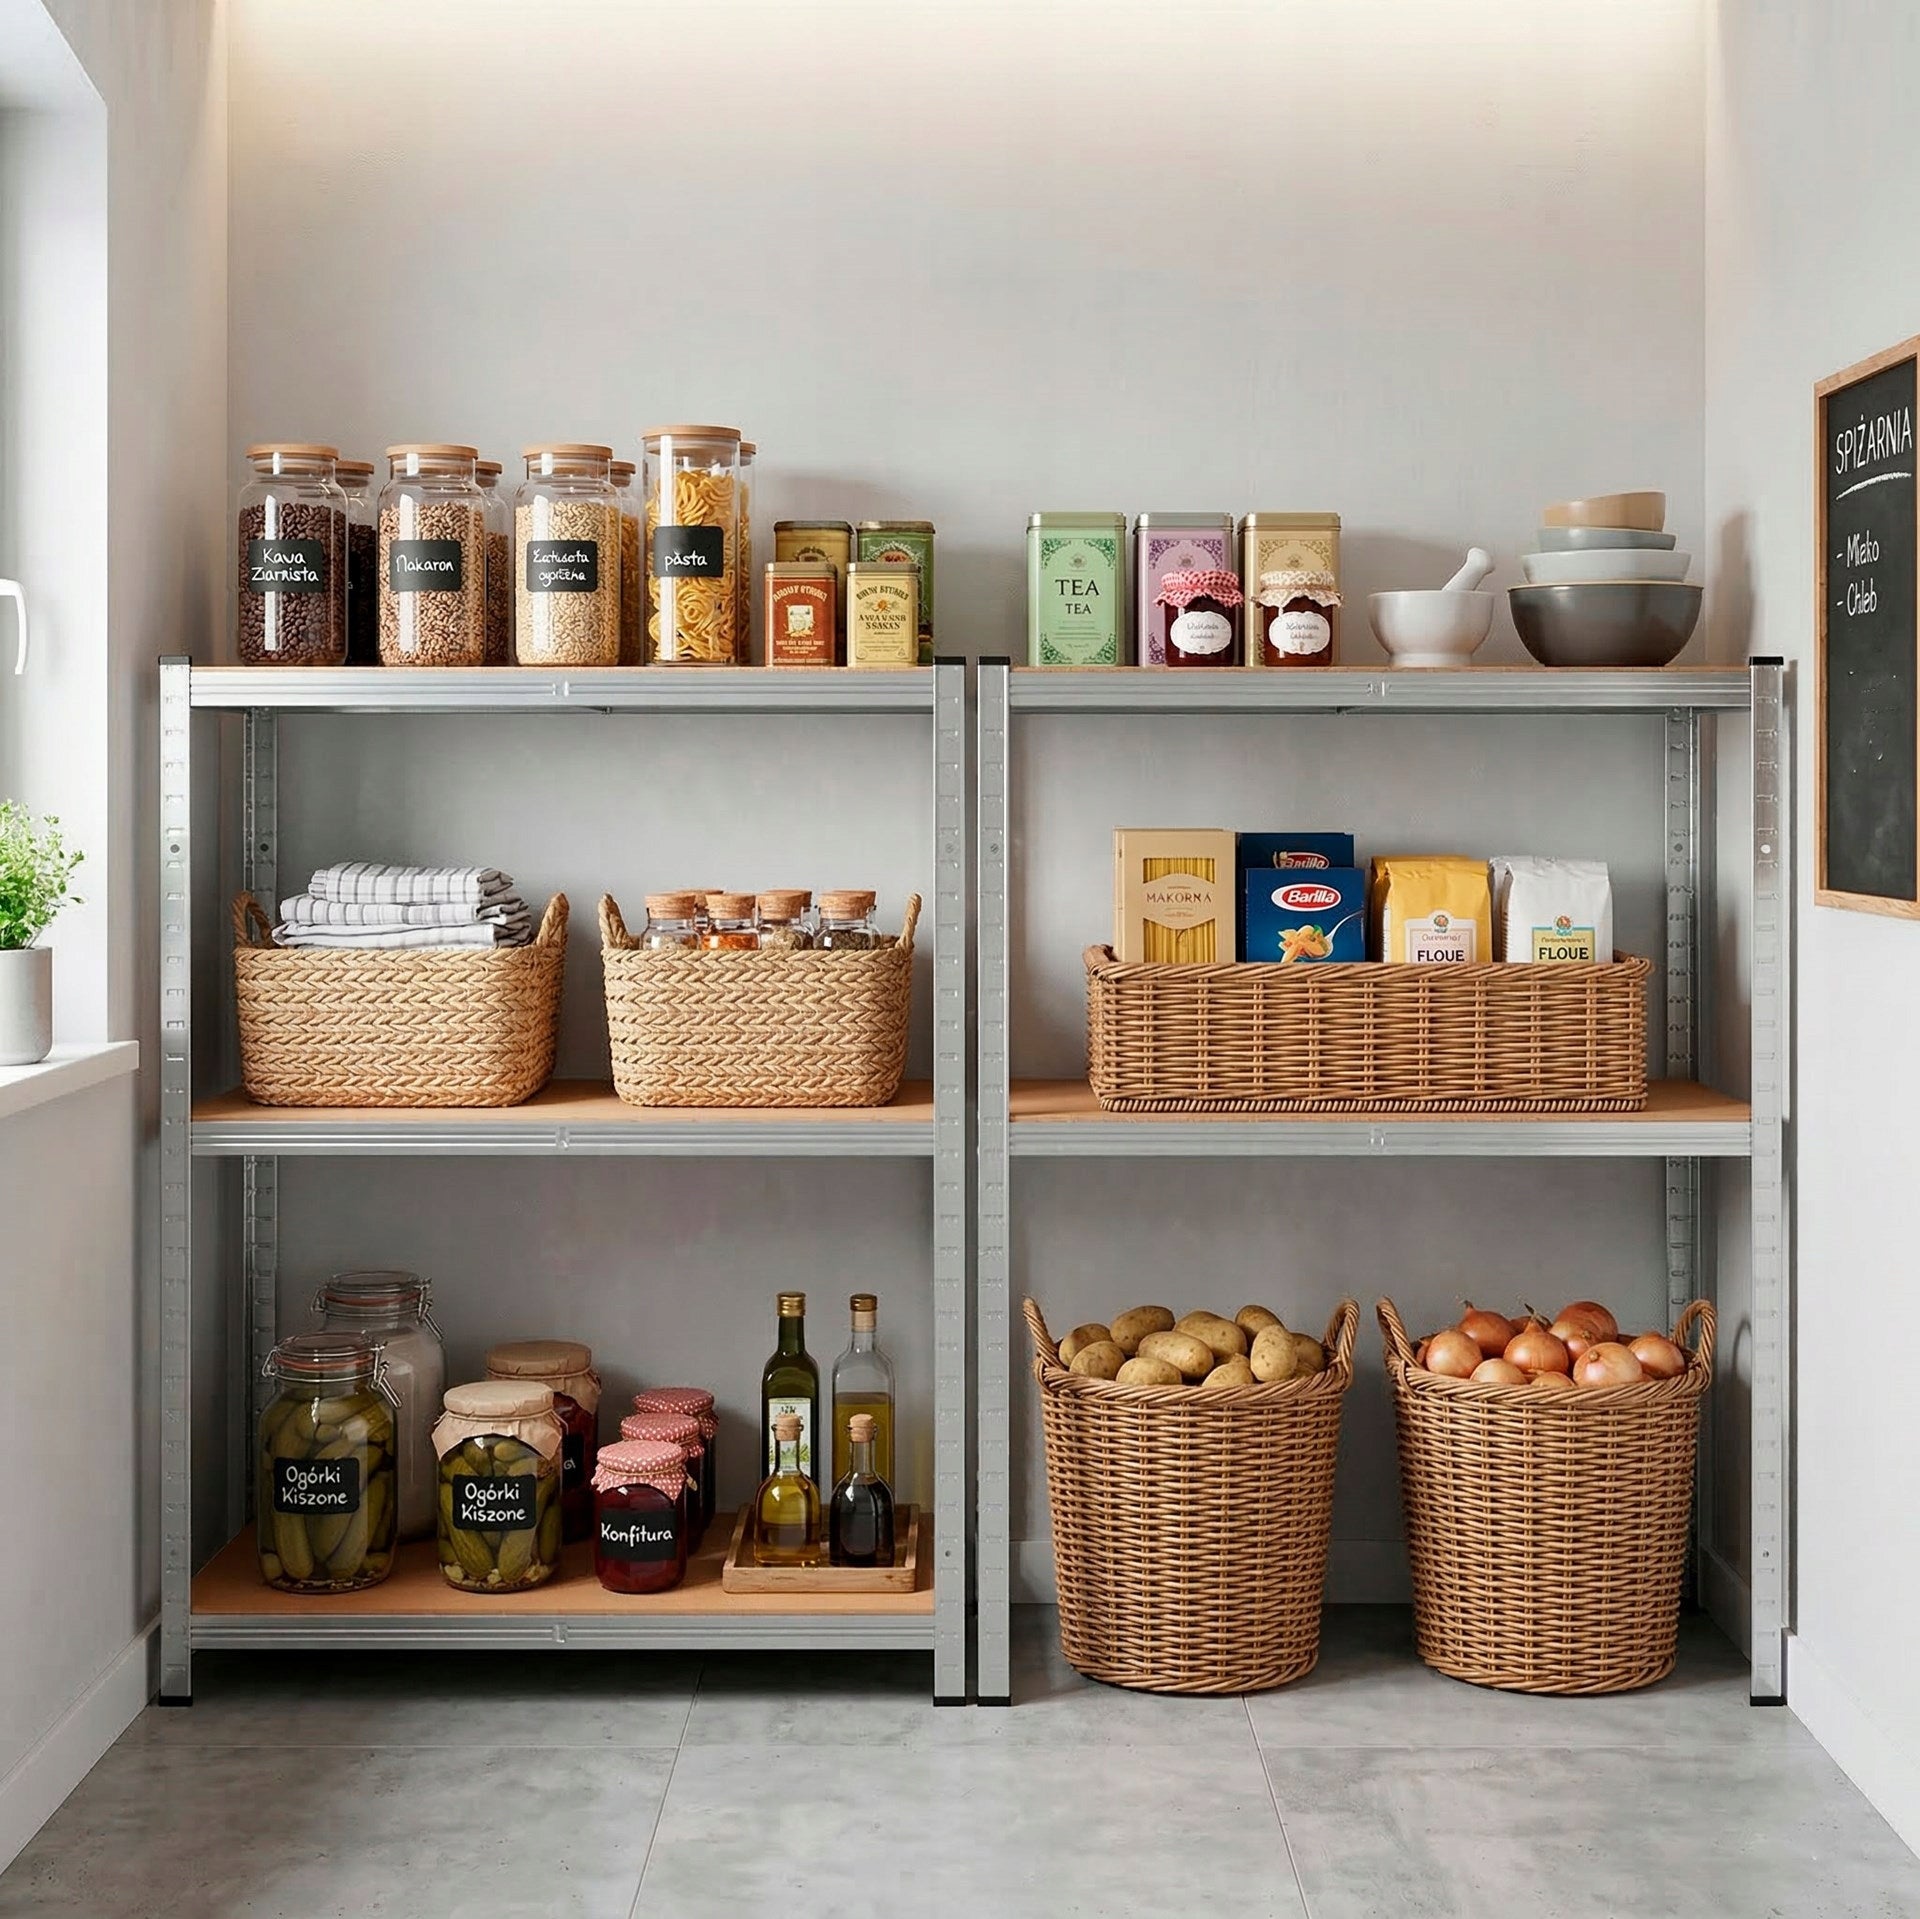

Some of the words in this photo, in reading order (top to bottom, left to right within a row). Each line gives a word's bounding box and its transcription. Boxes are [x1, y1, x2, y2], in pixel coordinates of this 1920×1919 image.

[1835, 406, 1913, 475] SPIŻARNIA
[1054, 578, 1100, 596] TEA
[1065, 603, 1092, 615] TEA
[1287, 889, 1336, 904] Barilla
[1417, 949, 1465, 962] FLOUE
[1538, 947, 1589, 960] FLOUE
[286, 1465, 341, 1490] Ogórki
[281, 1486, 349, 1505] Kiszone
[464, 1482, 520, 1508] Ogórki
[461, 1503, 527, 1522] Kiszone
[600, 1522, 674, 1547] Konfitura
